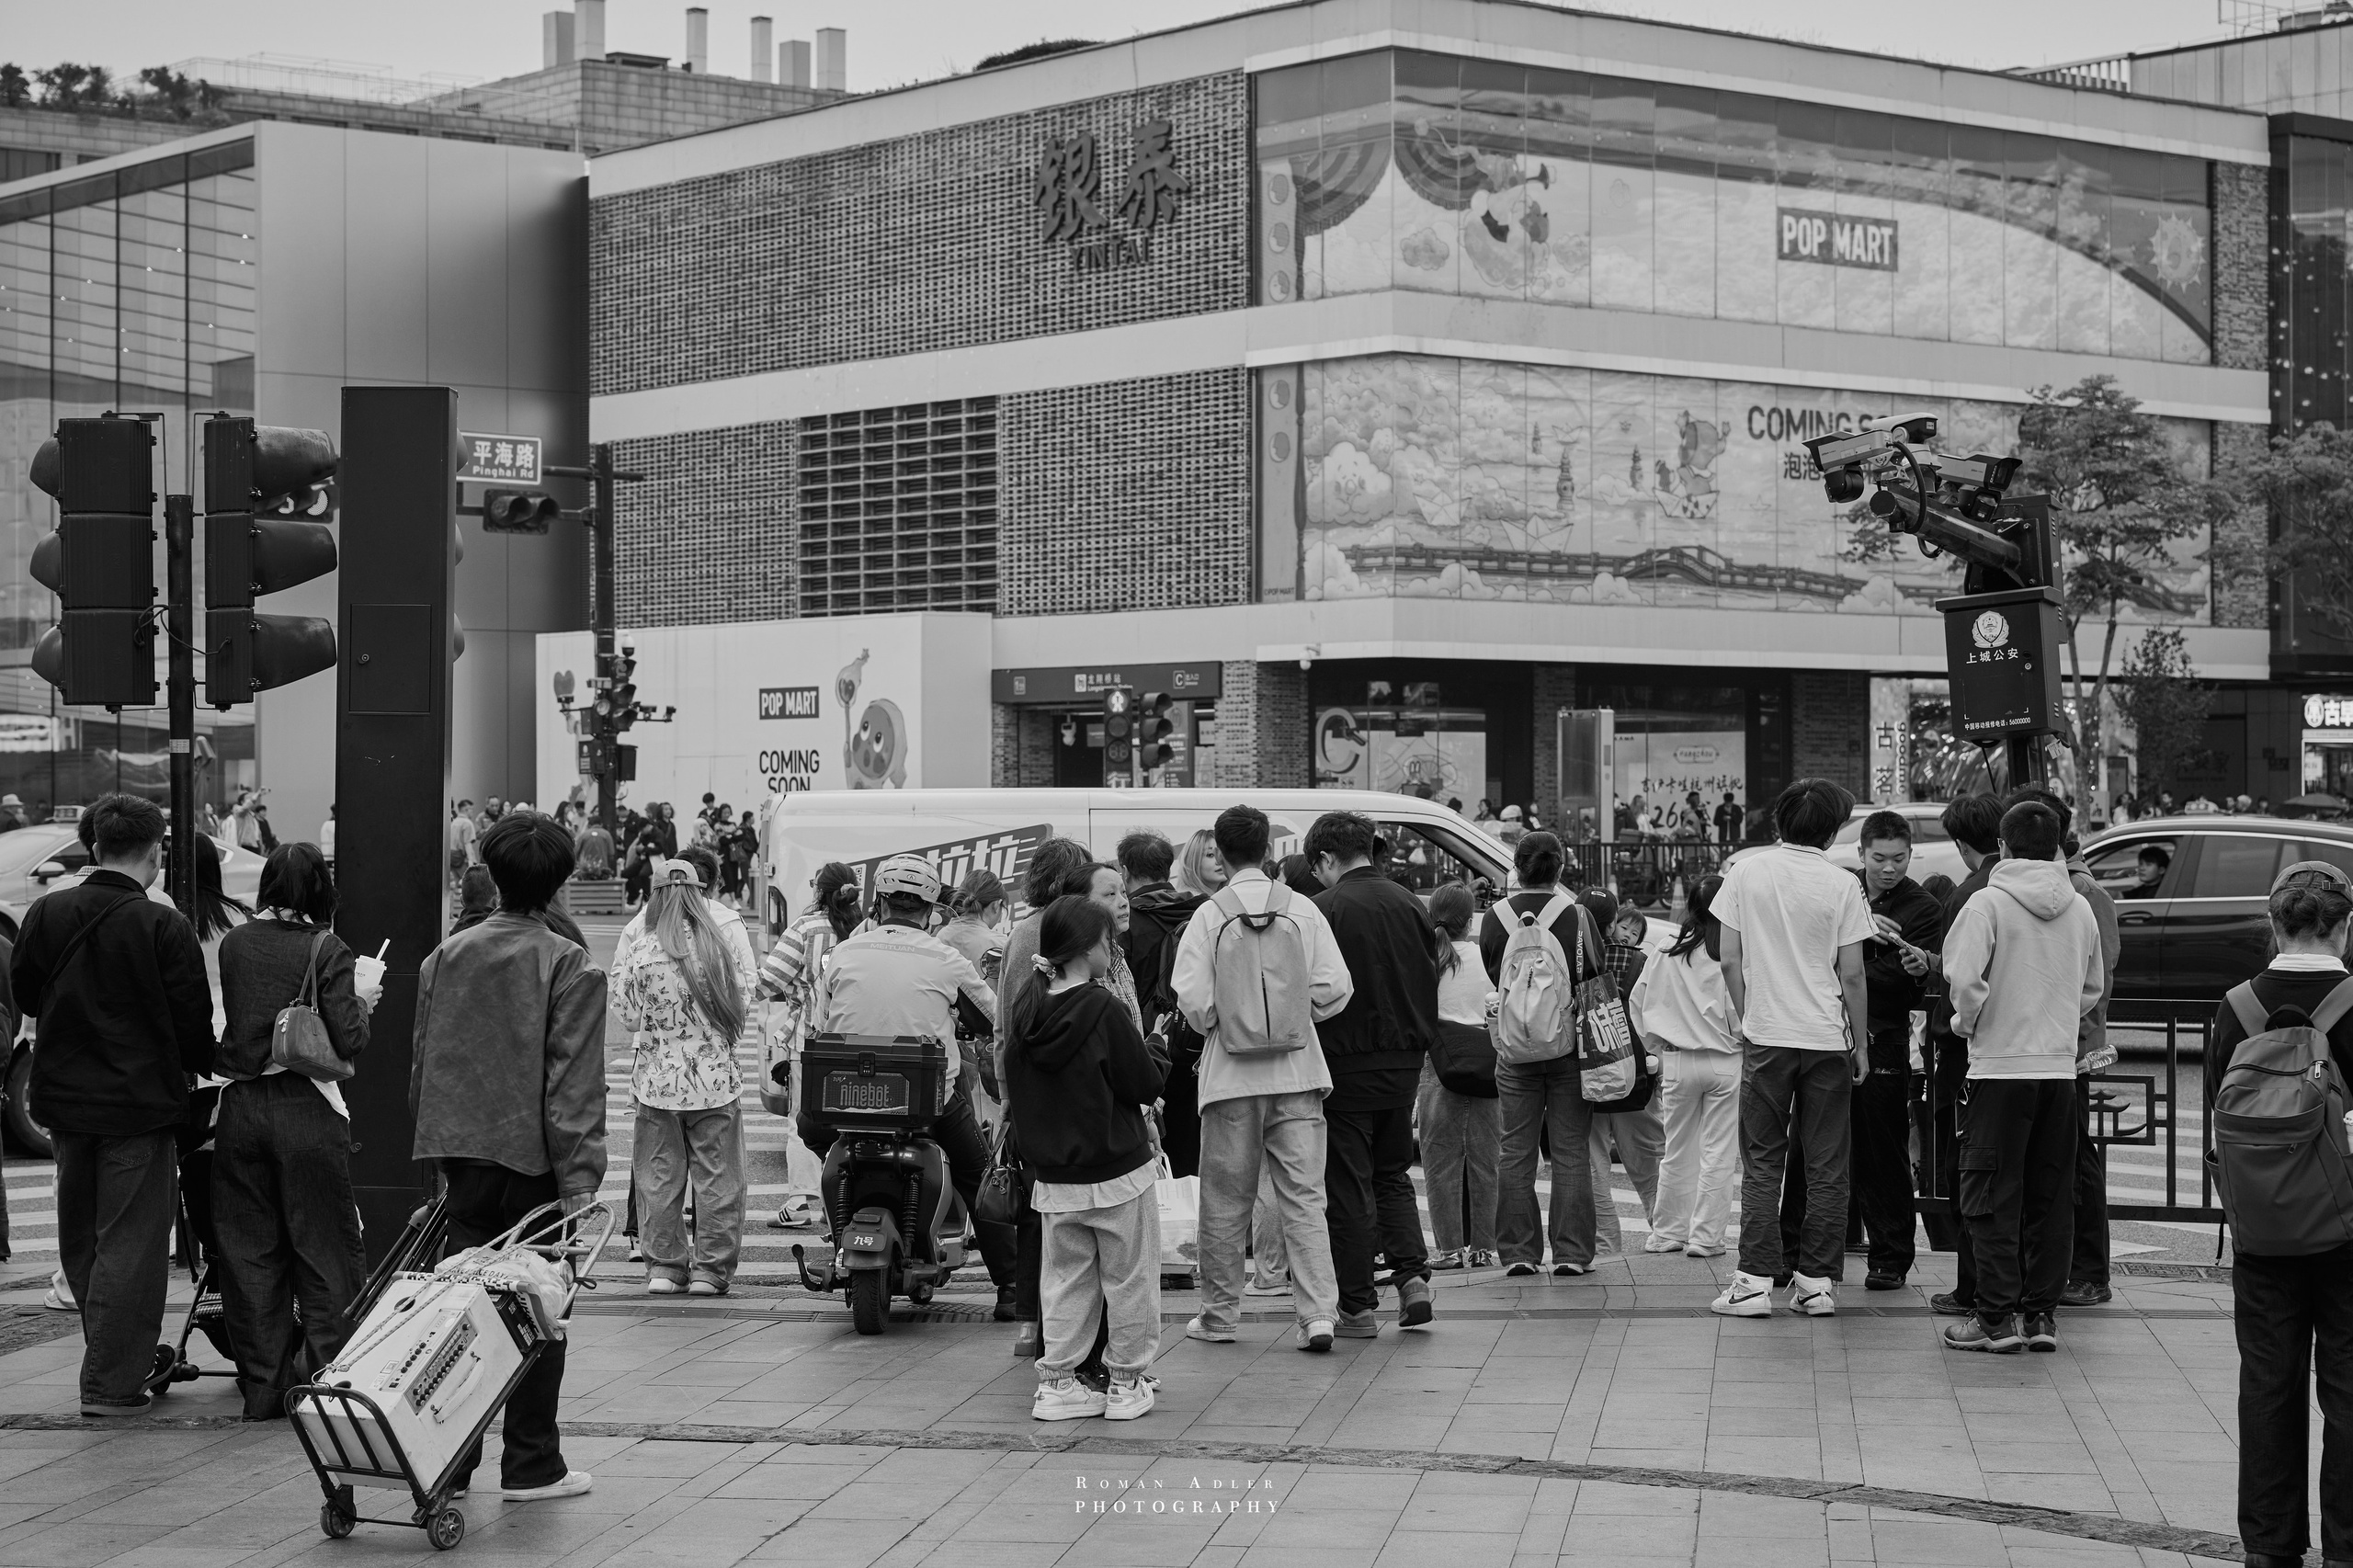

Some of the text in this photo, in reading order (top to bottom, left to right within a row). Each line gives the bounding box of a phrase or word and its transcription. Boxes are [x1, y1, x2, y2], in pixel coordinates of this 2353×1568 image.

[1782, 214, 1893, 265] POP MART
[1070, 237, 1149, 270] YINTAI
[472, 440, 534, 469] 平海路
[472, 465, 534, 478] Pinghai Rd
[1966, 648, 2018, 664] 上城公安
[1176, 674, 1183, 686] C
[761, 691, 817, 716] POP MART
[759, 750, 819, 774] COMING
[1895, 722, 1907, 795] goodme
[870, 943, 915, 952] MEITUAN
[840, 1081, 889, 1108] ninebot
[853, 1235, 874, 1246] 九号
